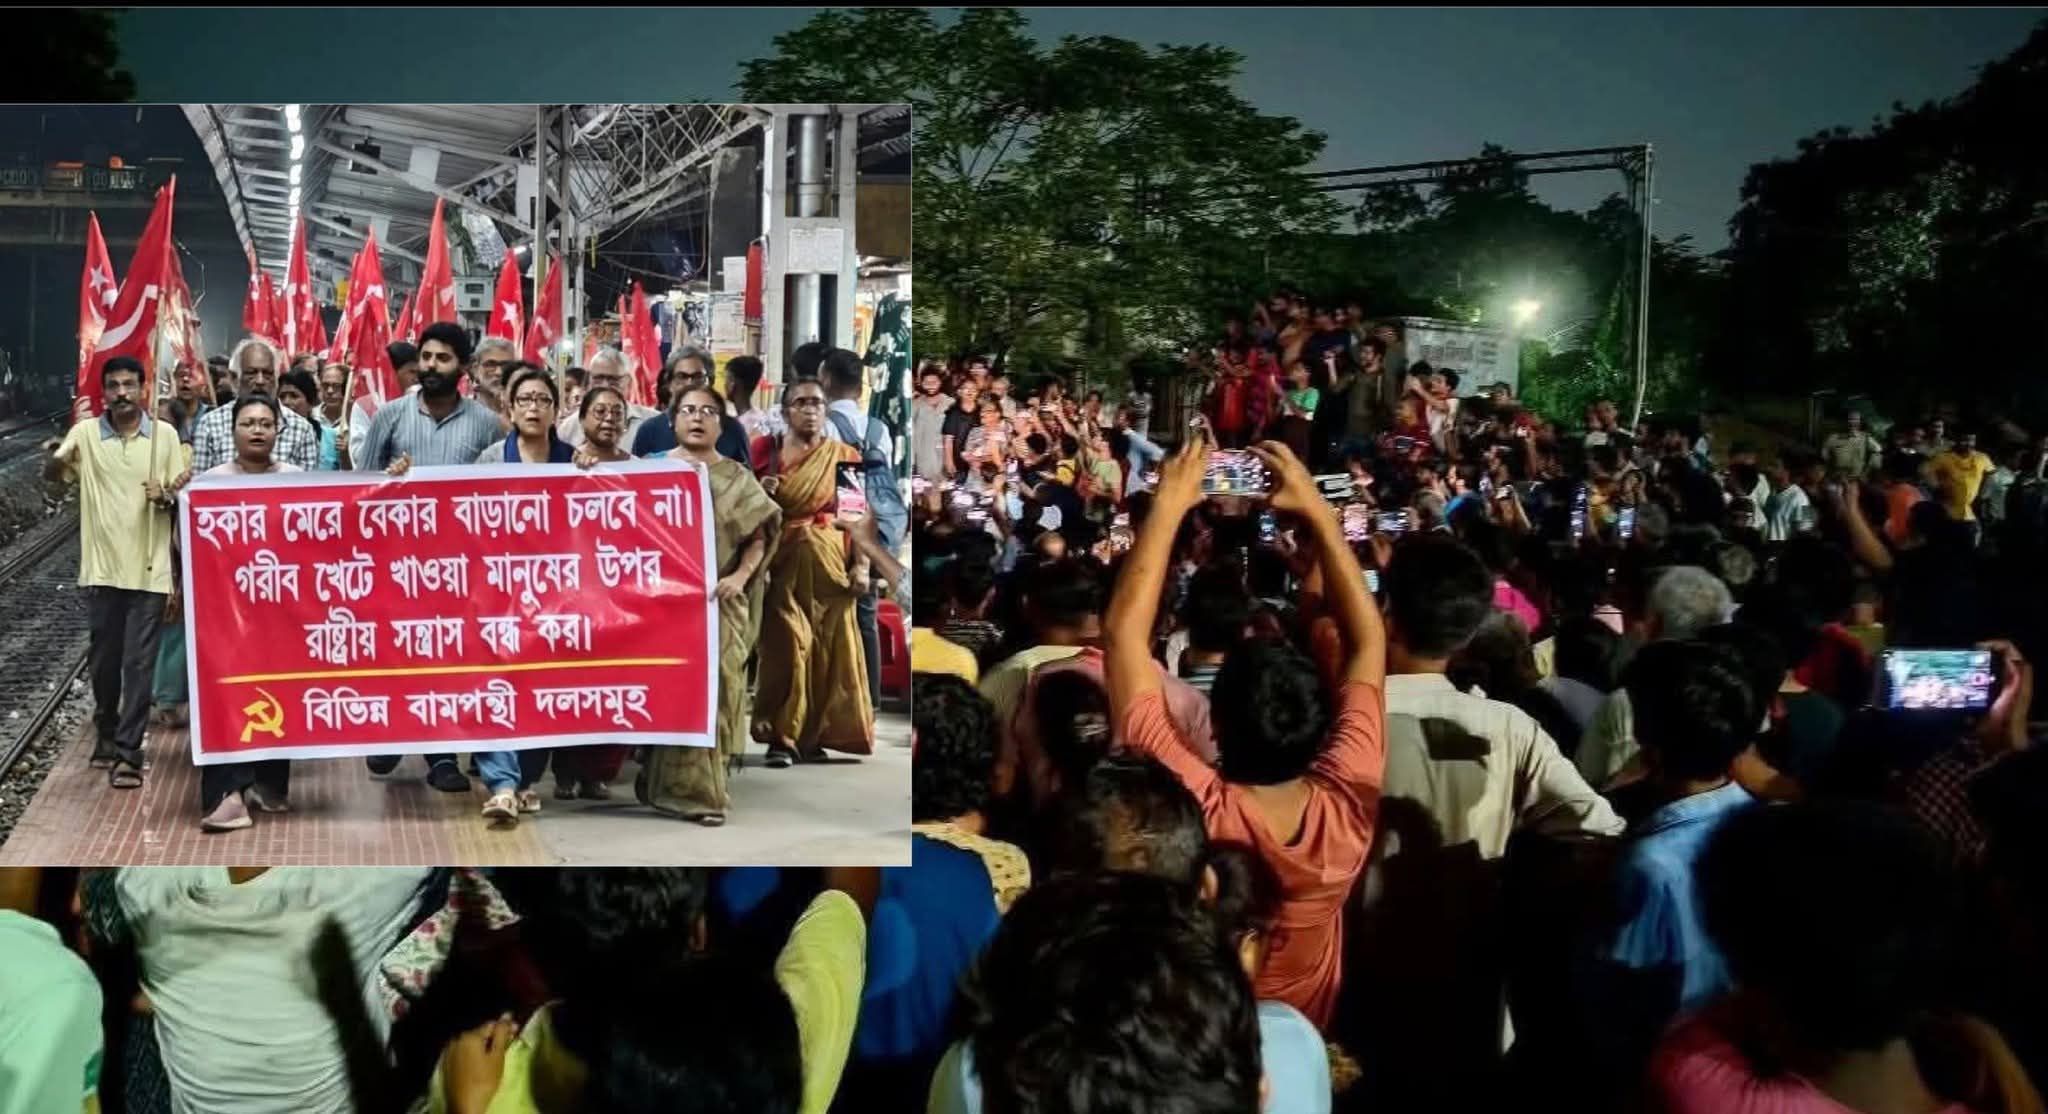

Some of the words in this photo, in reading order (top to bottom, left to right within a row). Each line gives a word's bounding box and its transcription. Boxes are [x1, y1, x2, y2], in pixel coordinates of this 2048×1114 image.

[194, 501, 267, 550] হকার
[280, 501, 344, 542] মেরে
[356, 494, 438, 539] বেকার
[451, 490, 551, 538] বাড়ানো
[564, 490, 638, 530] চলবে
[650, 484, 693, 529] না।
[235, 549, 300, 603] গরীব
[314, 546, 375, 602] খেটে
[390, 553, 469, 598] খাওয়া
[483, 552, 581, 609] মানুষের
[595, 537, 662, 590] উপর
[303, 606, 377, 665] রাষ্ট্রীয়
[391, 615, 464, 659] সন্ত্রাস
[477, 615, 521, 654] বন্ধ
[534, 614, 591, 651] কর।
[302, 687, 391, 731] বিভিন্ন
[405, 678, 518, 731] বামপন্থী
[532, 685, 654, 730] দলসমূহ
